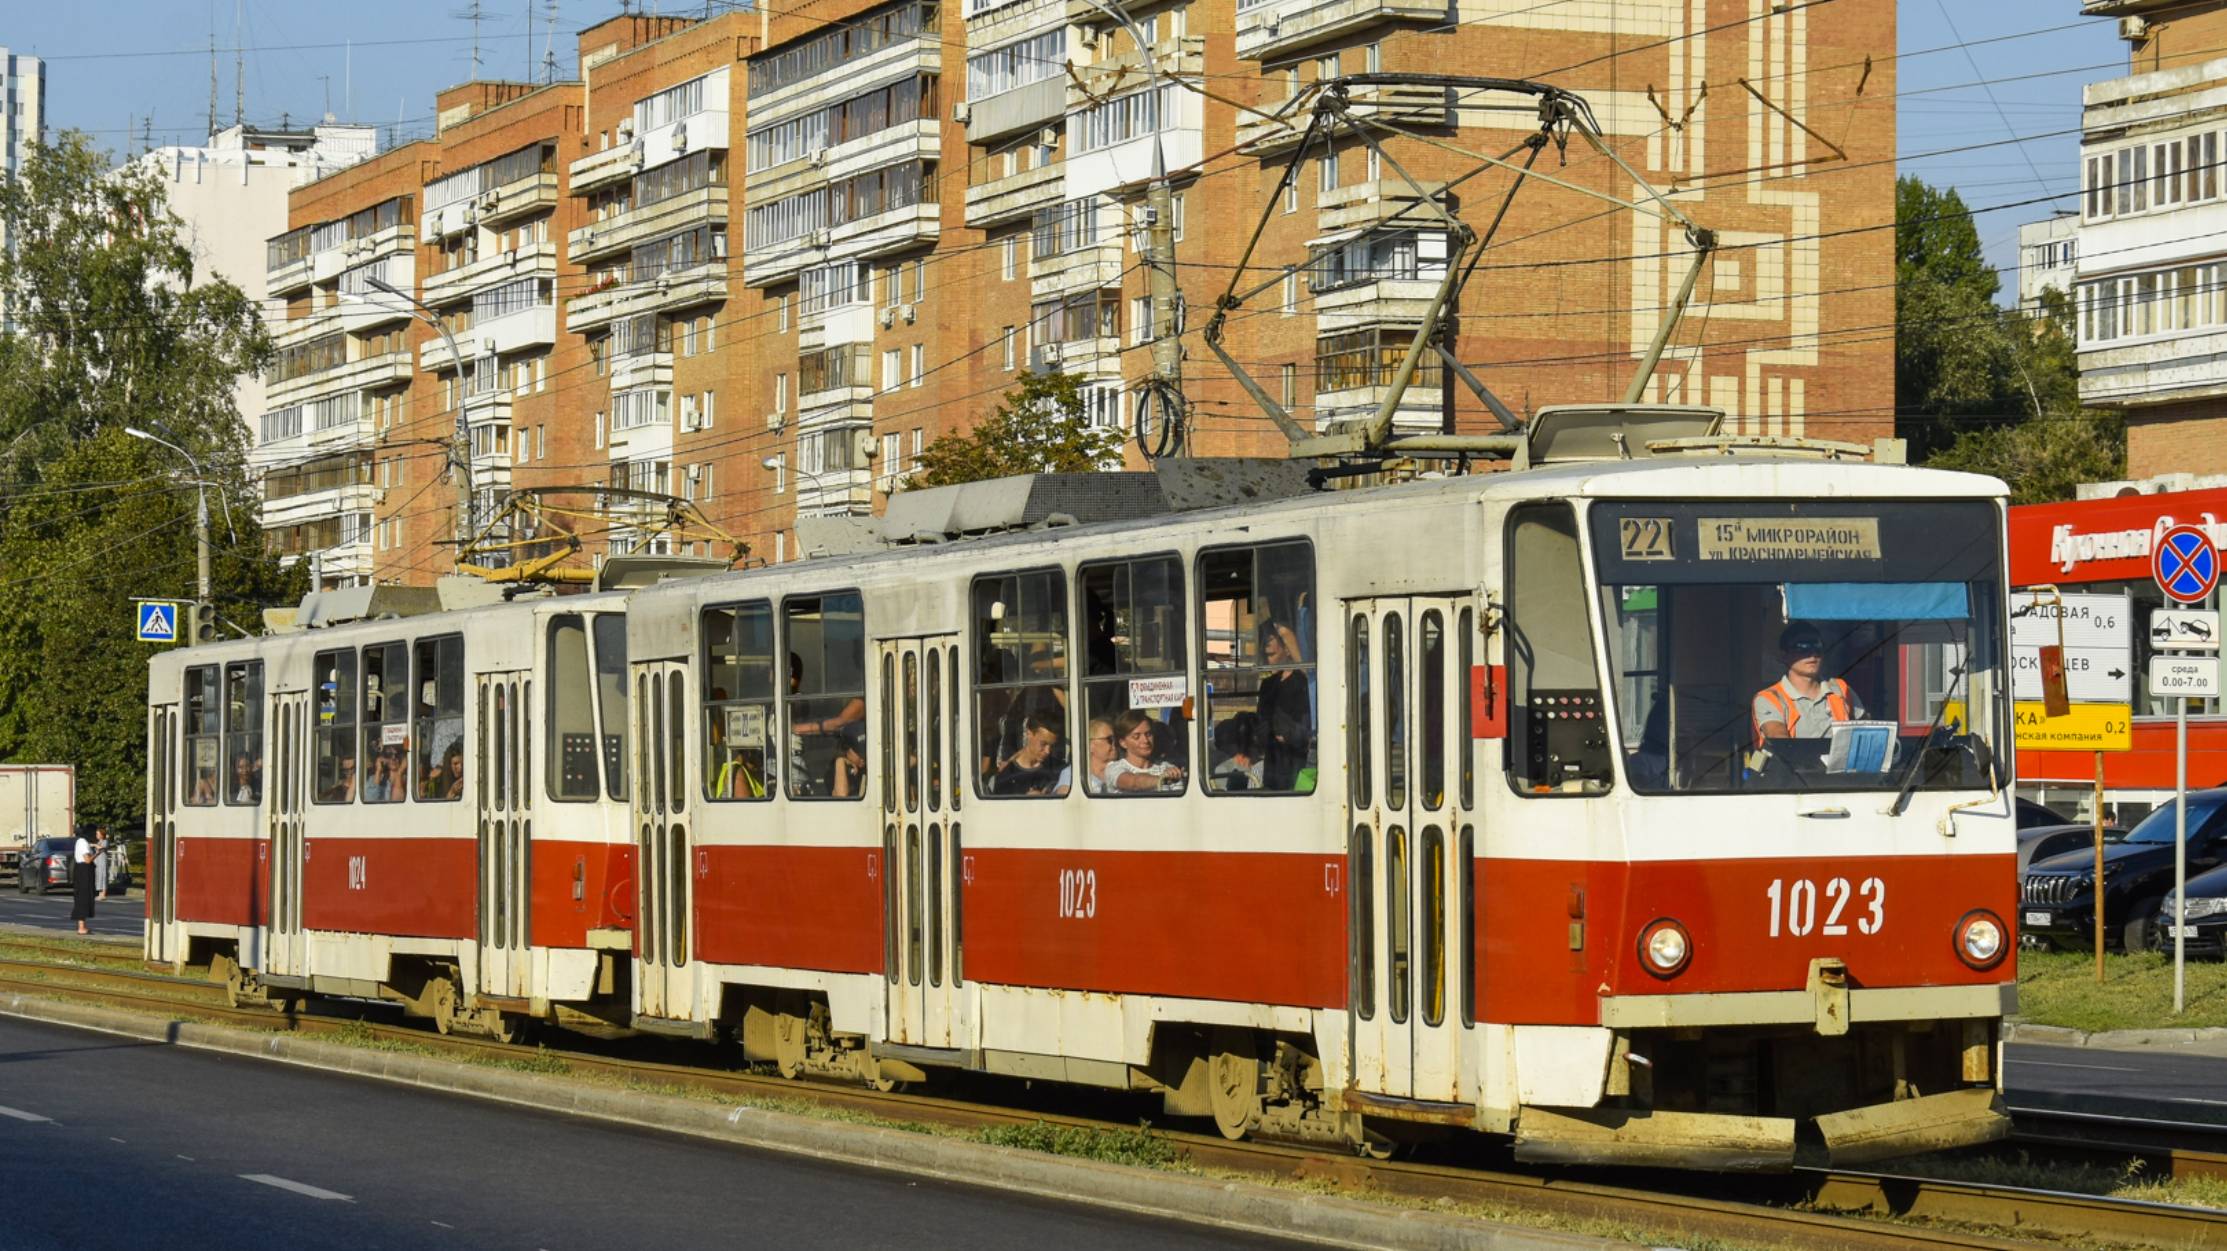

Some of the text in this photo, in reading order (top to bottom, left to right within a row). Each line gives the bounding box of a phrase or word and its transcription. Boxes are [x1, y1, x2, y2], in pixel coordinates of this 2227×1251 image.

[1622, 519, 1664, 557] 22
[1746, 526, 1860, 545] МИКРОРАЙОН
[2094, 616, 2115, 629] 0,6
[2171, 665, 2199, 674] среда
[2050, 733, 2103, 741] компания
[2105, 721, 2126, 735] 0,2
[348, 856, 366, 890] 1024
[1059, 869, 1096, 918] 1023
[1767, 877, 1885, 937] 1023
